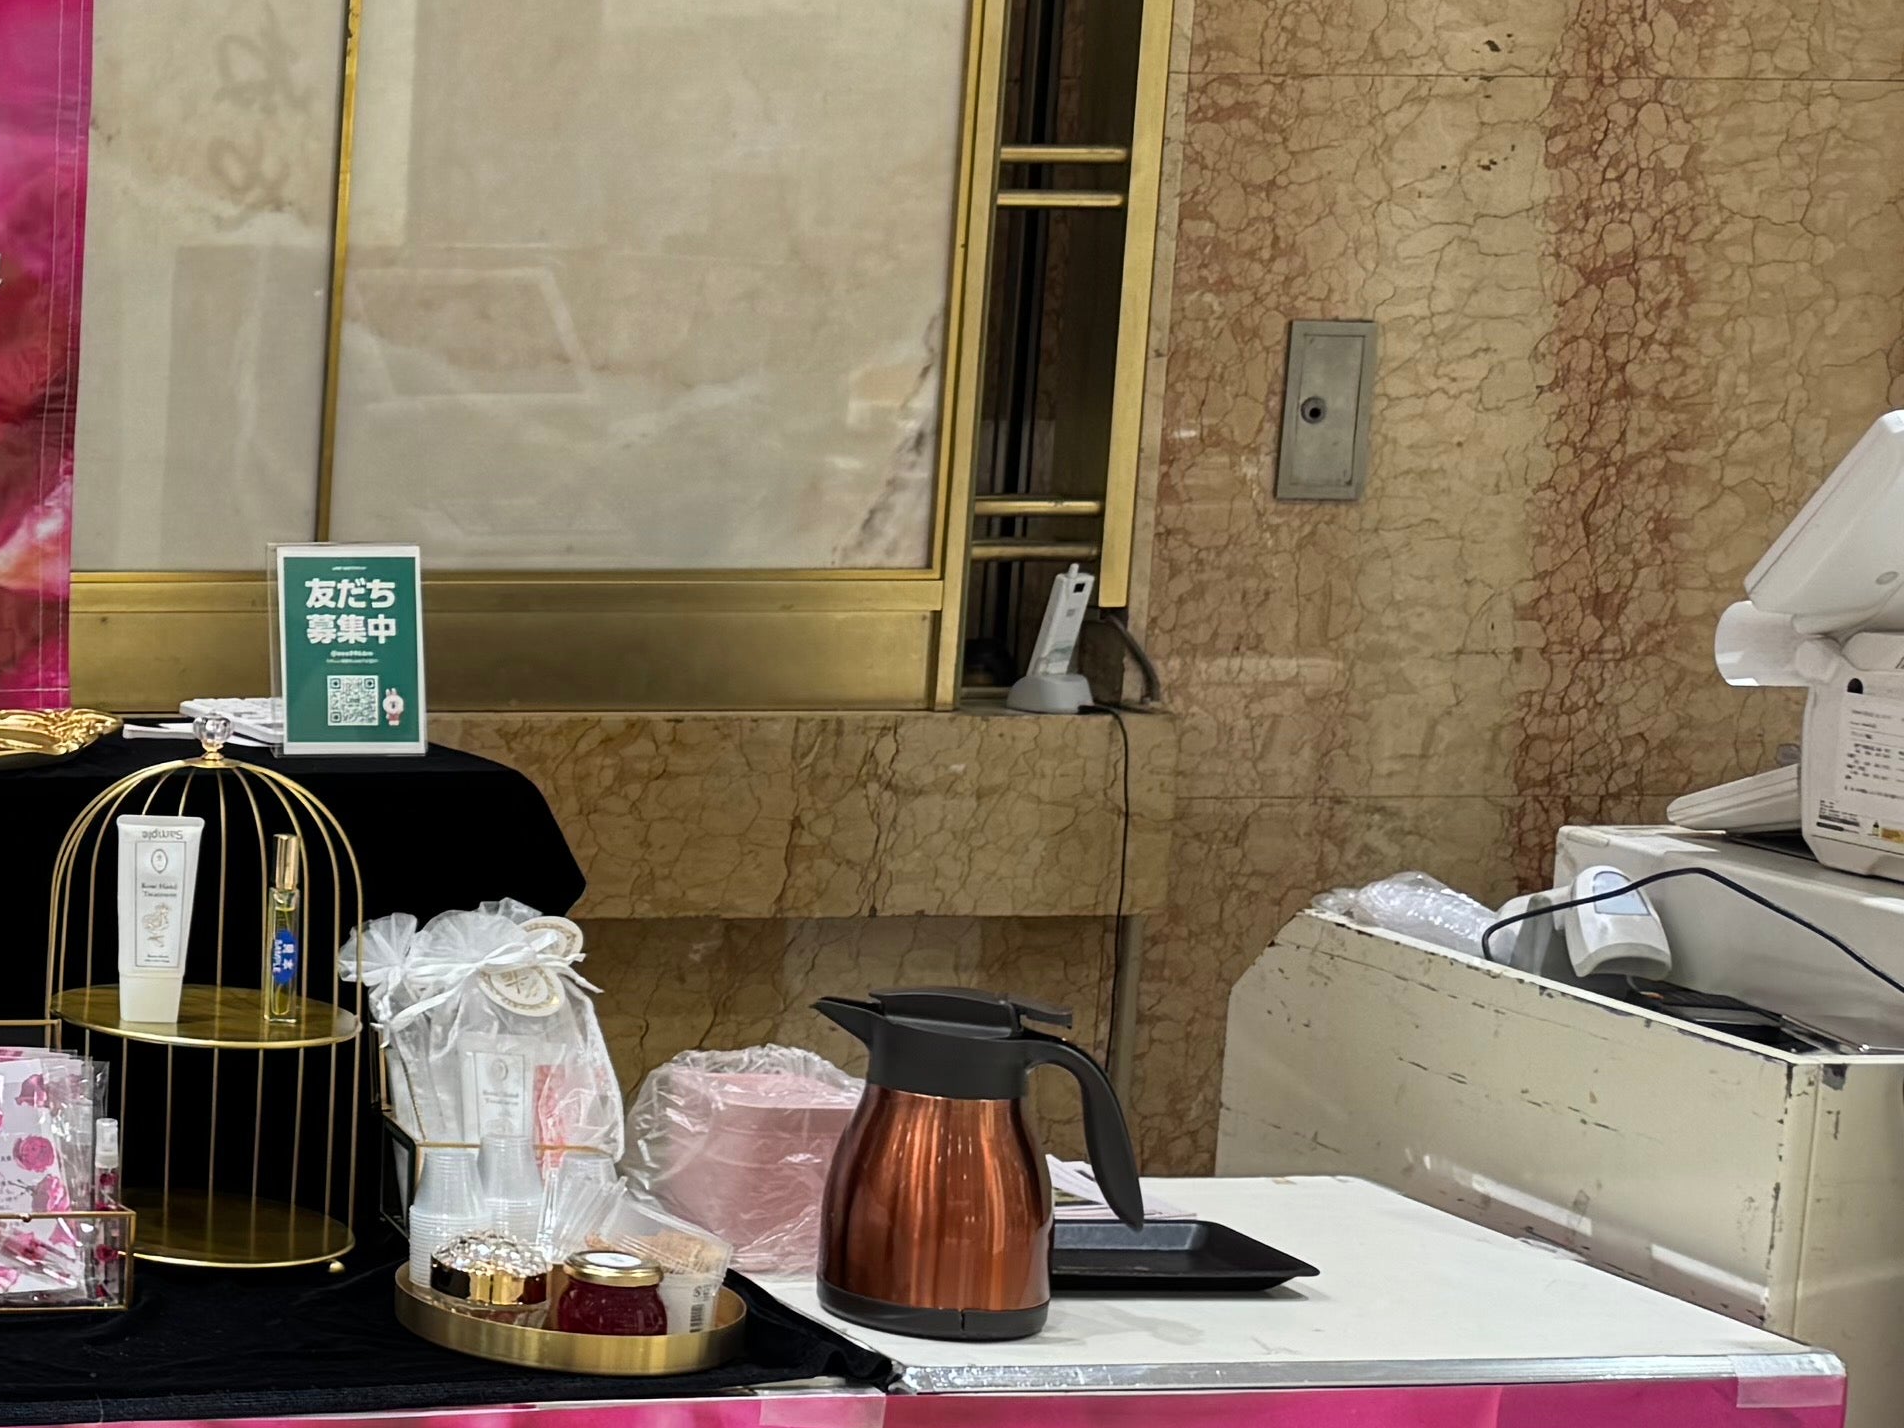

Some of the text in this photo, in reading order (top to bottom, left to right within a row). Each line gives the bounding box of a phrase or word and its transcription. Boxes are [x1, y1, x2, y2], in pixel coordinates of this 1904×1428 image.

[304, 577, 396, 609] 友だち
[306, 613, 397, 645] 募集中
[142, 828, 184, 842] Sample
